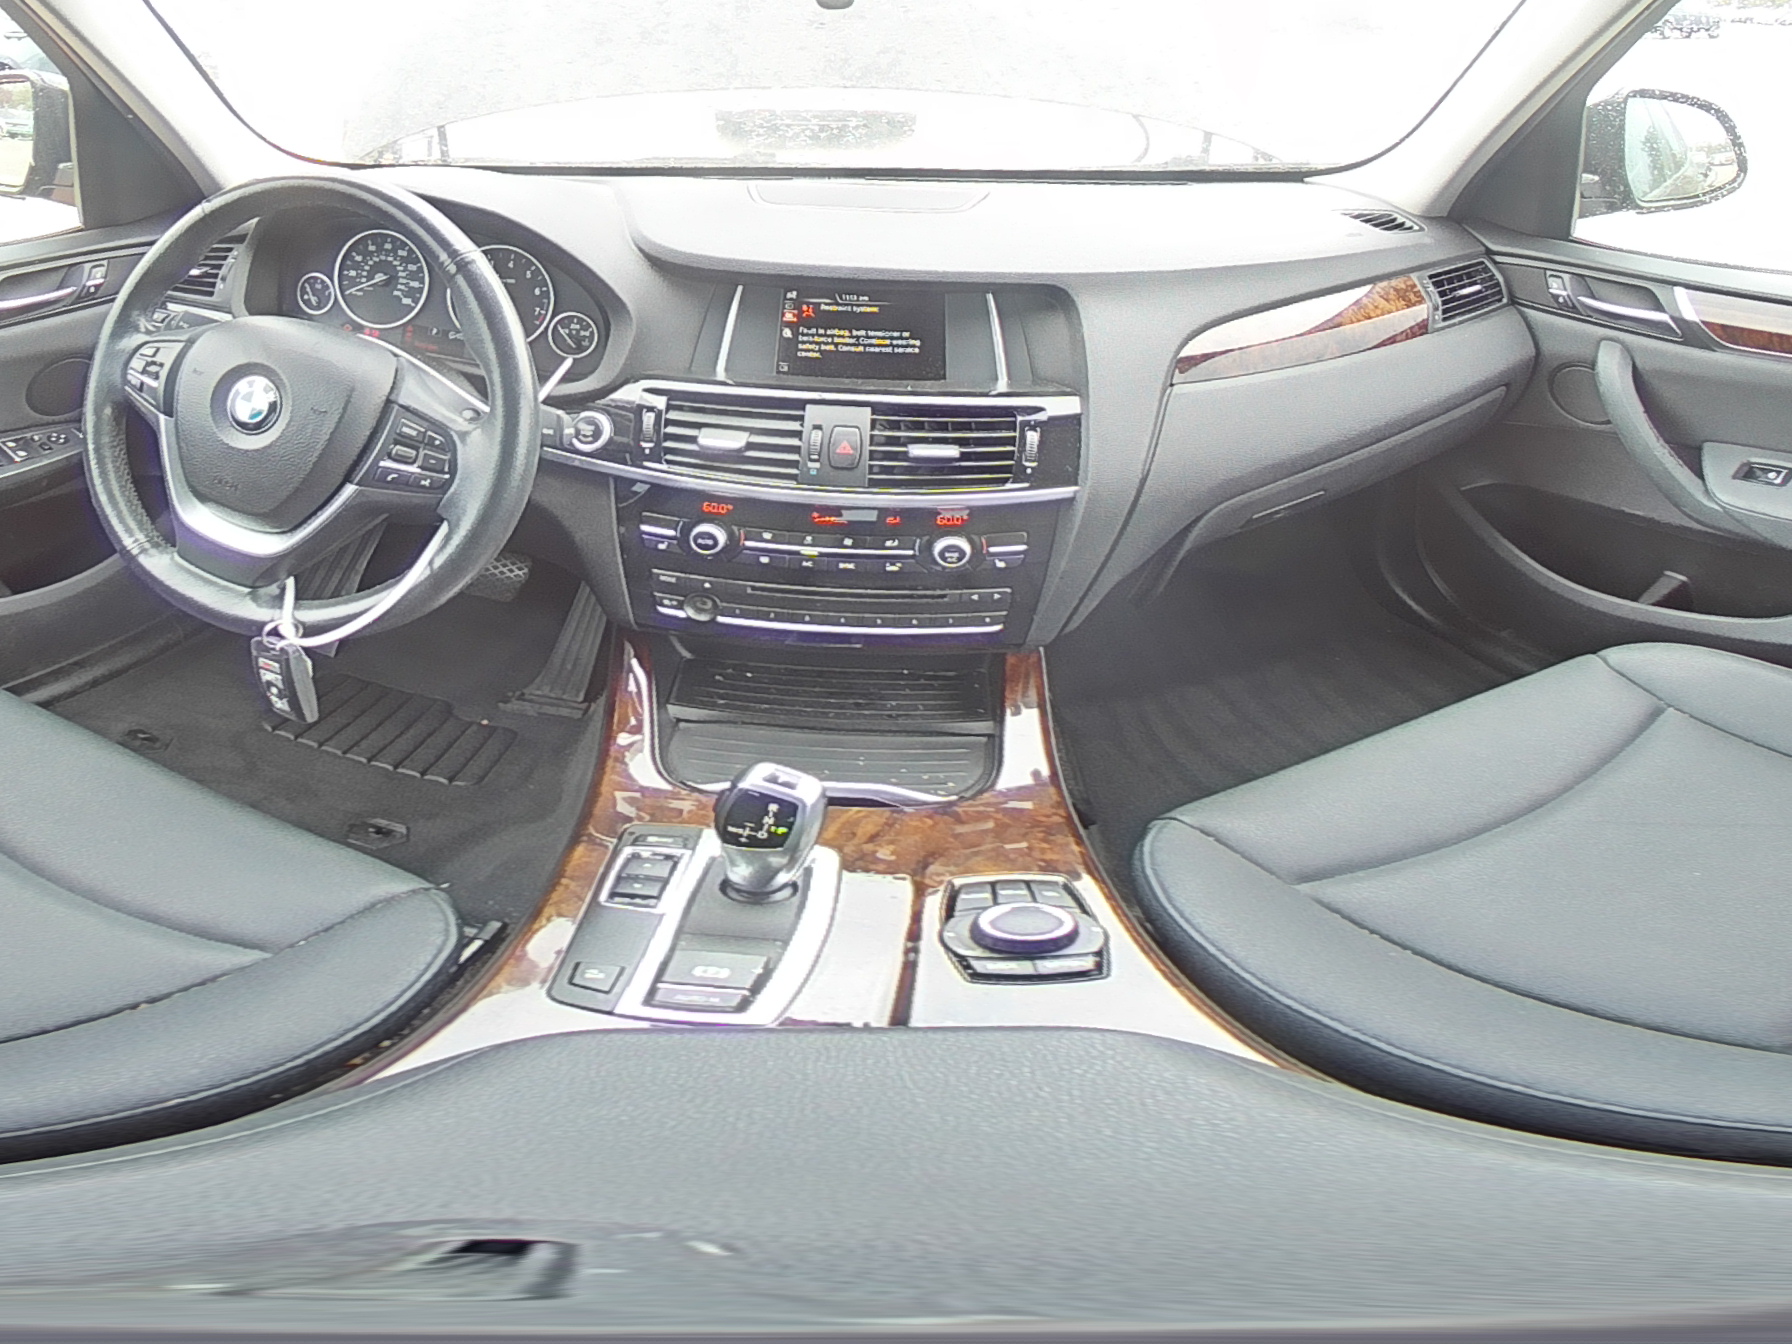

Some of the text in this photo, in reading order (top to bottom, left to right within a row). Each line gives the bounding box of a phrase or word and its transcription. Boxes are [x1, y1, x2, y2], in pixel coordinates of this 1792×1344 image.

[820, 304, 852, 312] Restraint
[799, 326, 816, 334] Fault
[818, 327, 825, 335] in
[892, 338, 921, 347] wearing
[798, 343, 819, 351] safety
